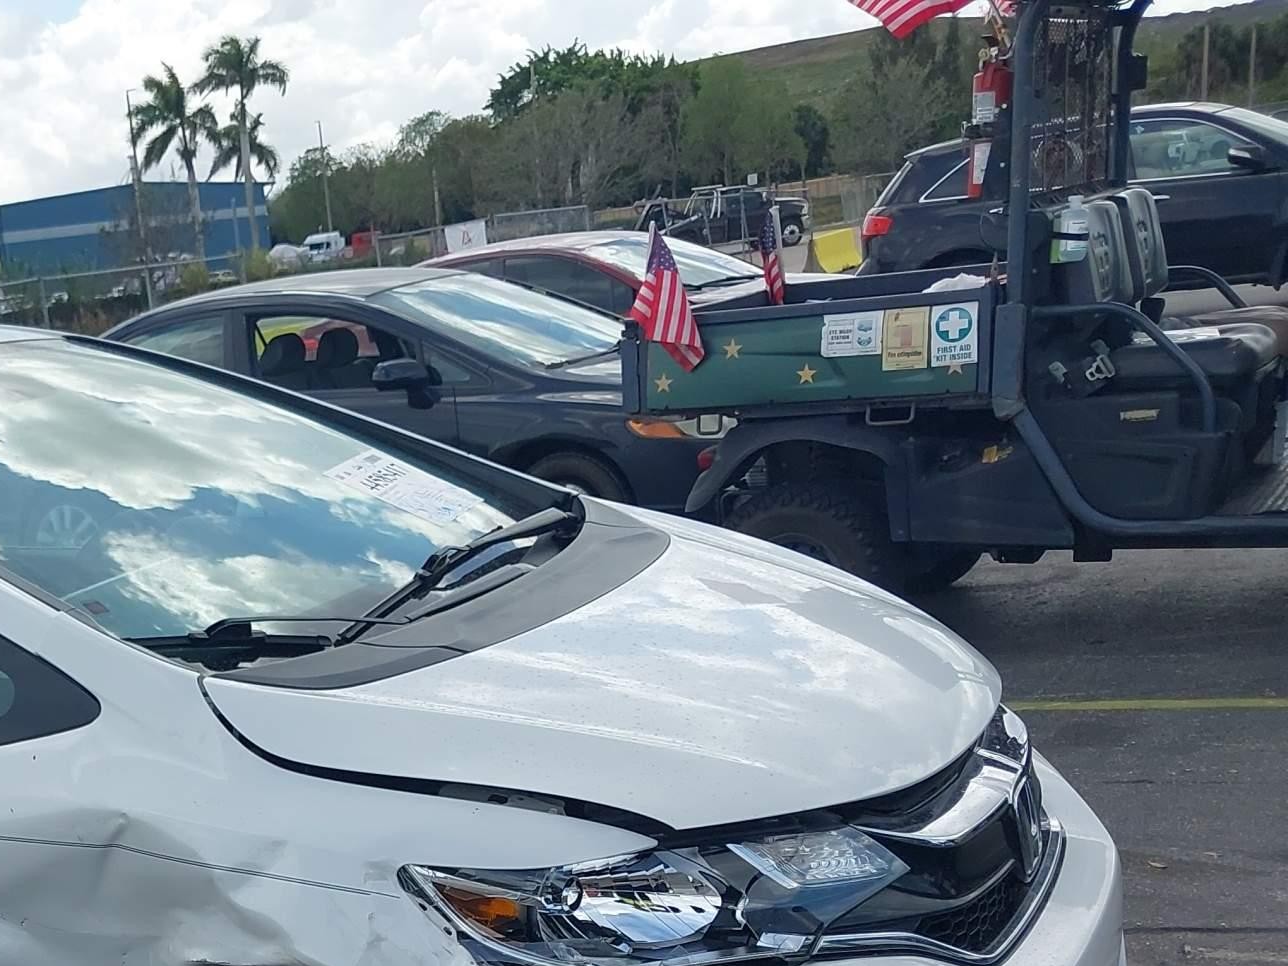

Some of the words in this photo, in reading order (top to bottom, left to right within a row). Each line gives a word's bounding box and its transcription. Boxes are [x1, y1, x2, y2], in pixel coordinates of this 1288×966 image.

[936, 346, 957, 354] FIRST
[959, 344, 972, 352] AID
[936, 354, 947, 362] KIT
[949, 352, 973, 361] INSIDE
